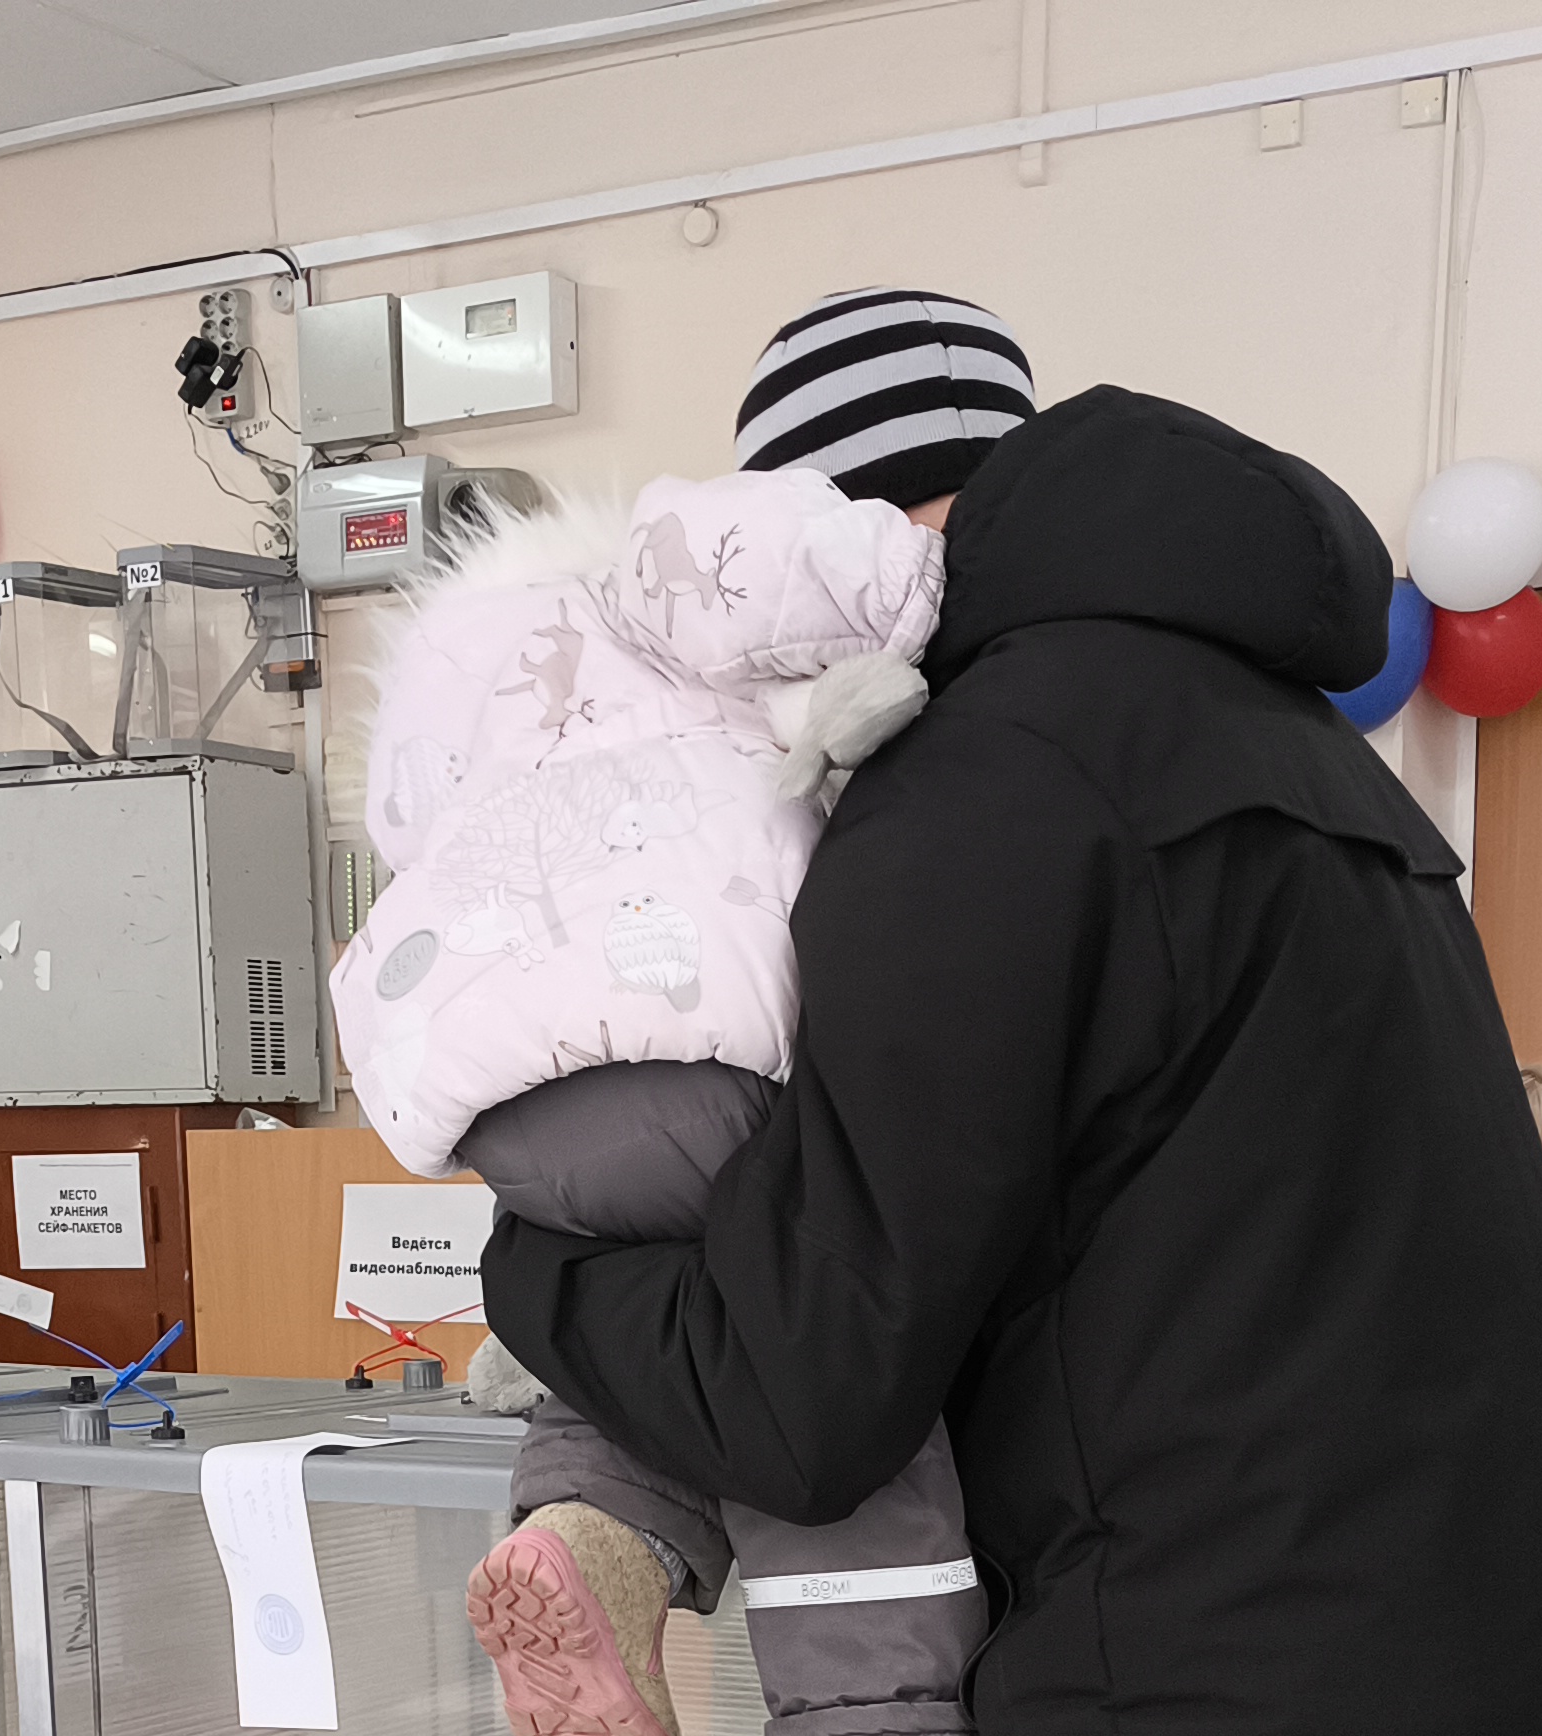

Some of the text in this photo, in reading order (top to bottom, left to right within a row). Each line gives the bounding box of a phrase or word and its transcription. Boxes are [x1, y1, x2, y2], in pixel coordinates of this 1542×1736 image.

[245, 420, 270, 438] 220V
[130, 565, 159, 585] №2
[59, 1189, 97, 1201] МЕСТО
[50, 1206, 108, 1218] ХРАНЕНИЯ
[38, 1221, 123, 1236] СЕЙФ-ПАКЕТОВ
[391, 1235, 451, 1252] Ведётся
[349, 1260, 481, 1277] видеонаблюдени
